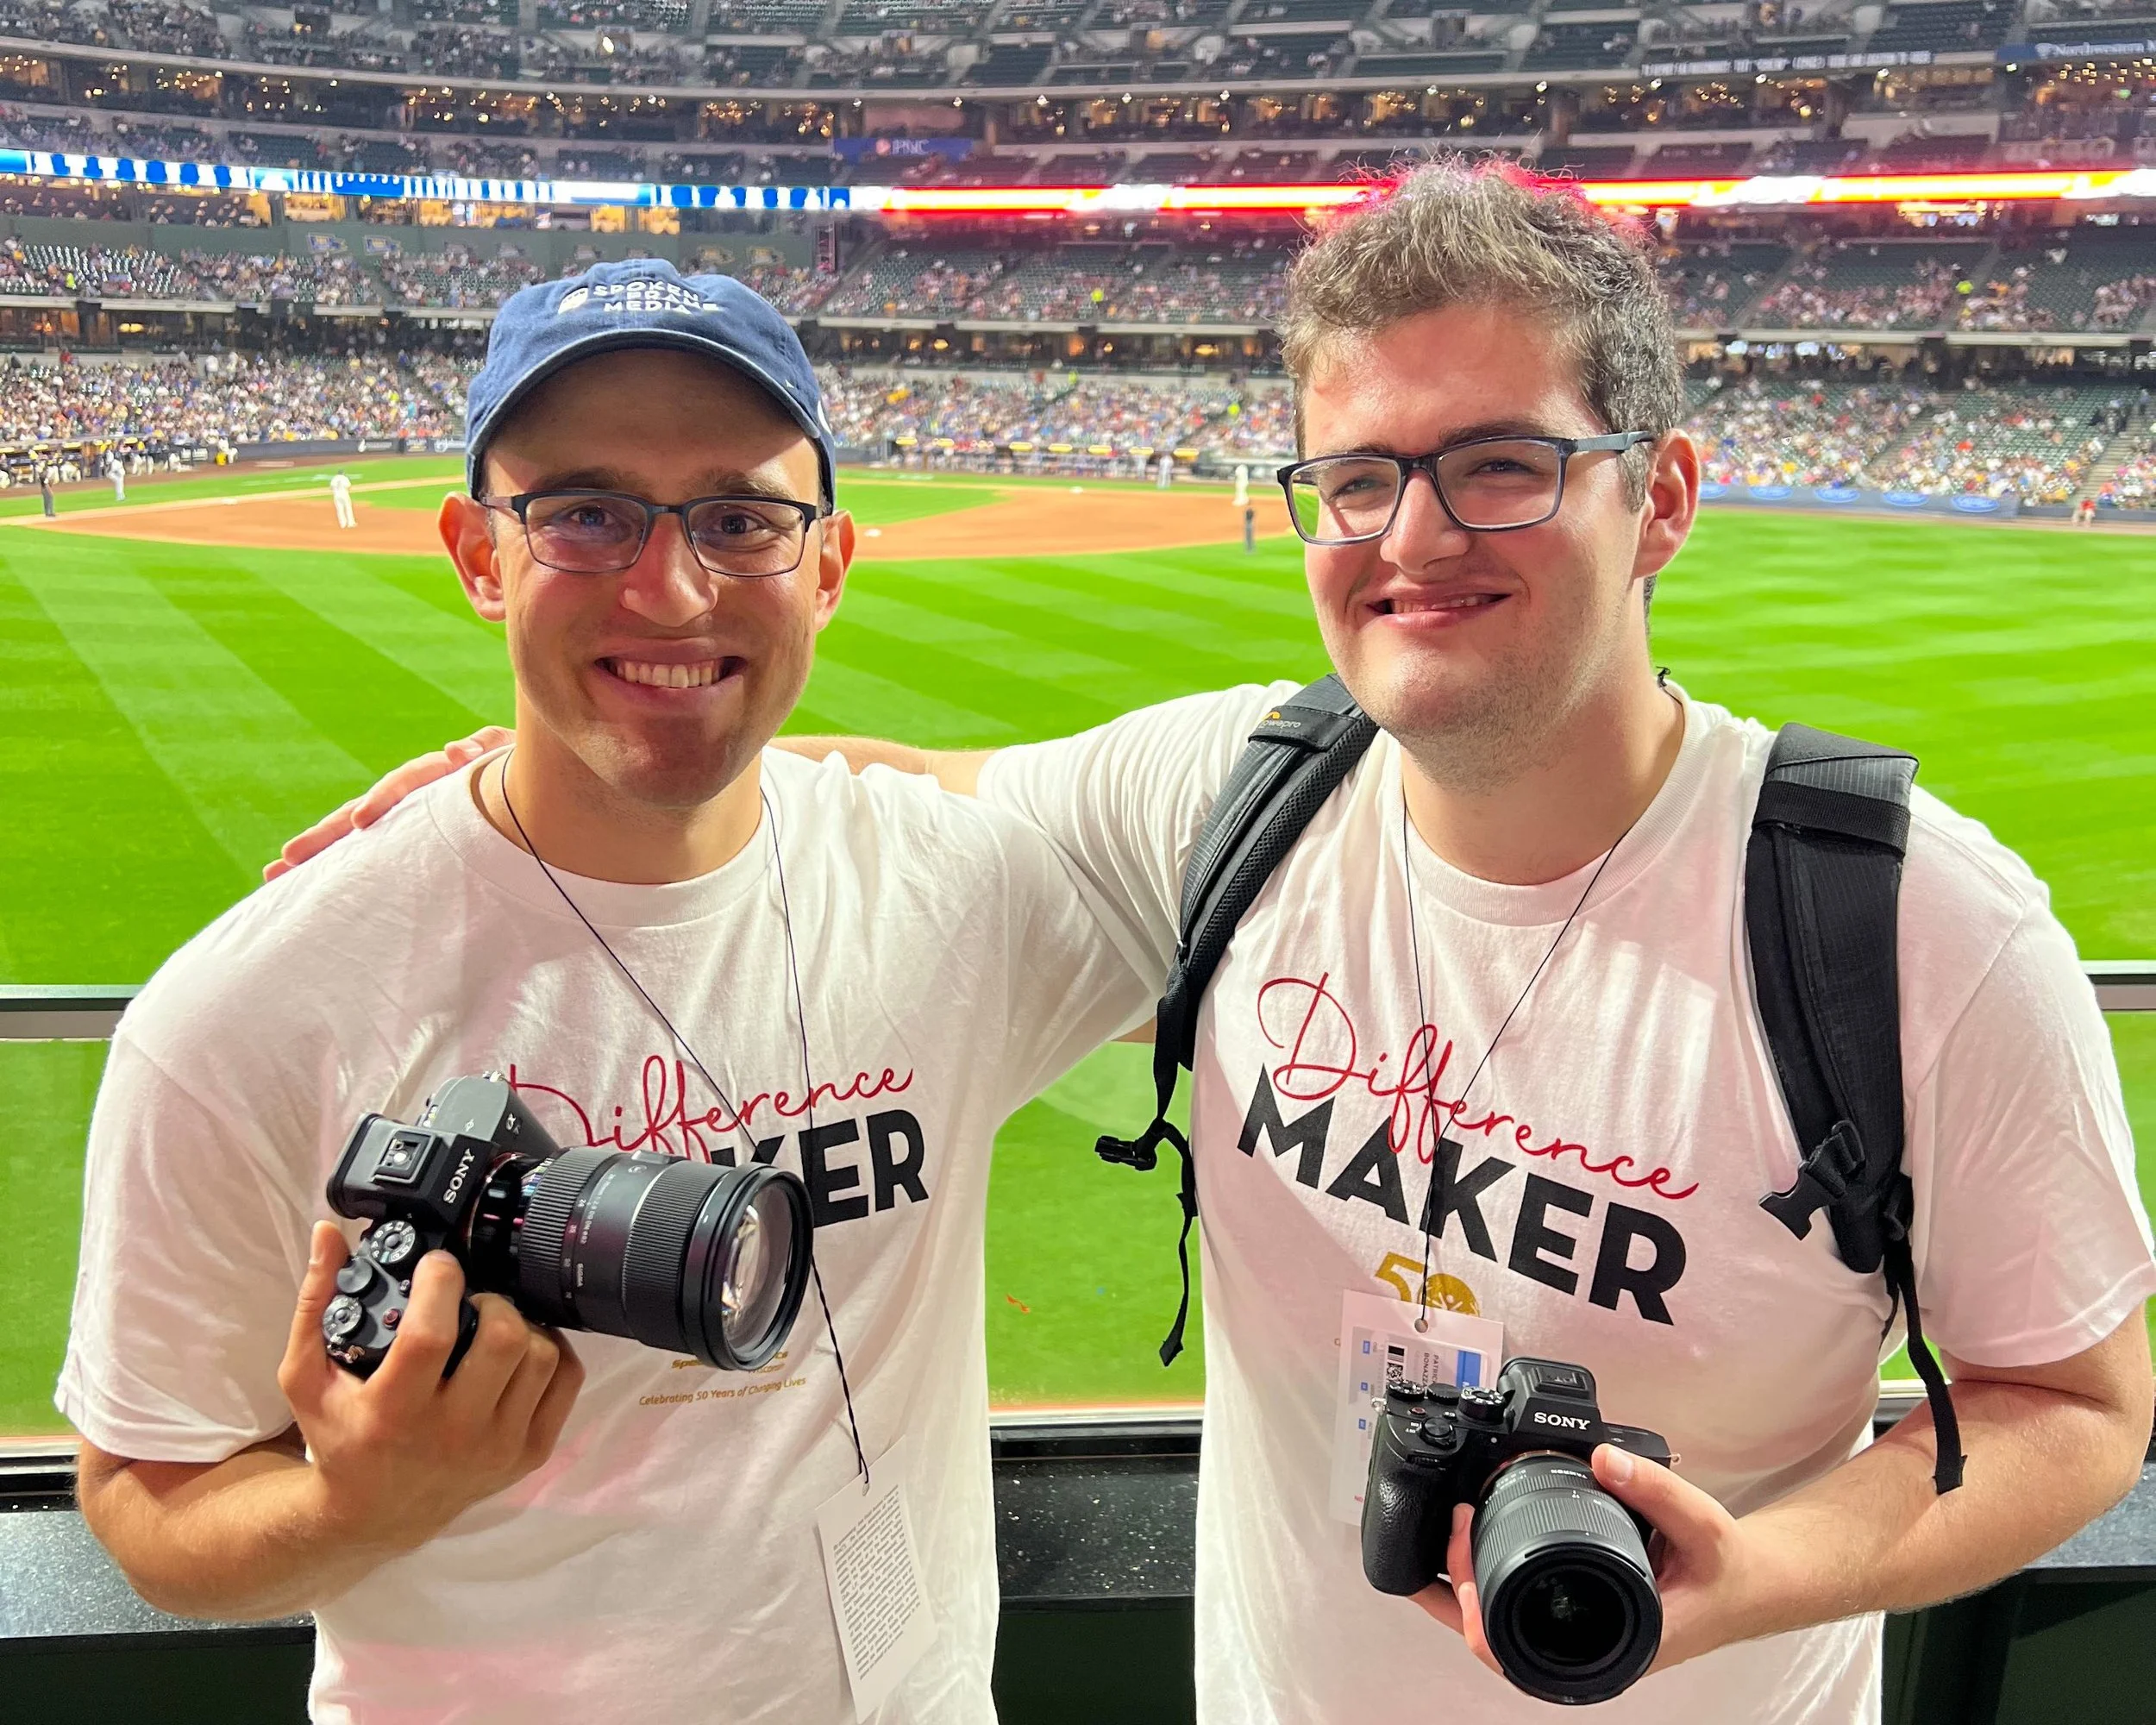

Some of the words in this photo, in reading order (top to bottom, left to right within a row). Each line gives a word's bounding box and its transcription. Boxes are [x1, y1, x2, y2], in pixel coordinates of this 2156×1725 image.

[892, 139, 930, 155] PNC
[593, 281, 699, 302] SPOKEN
[604, 300, 693, 315] MEDIA
[1257, 971, 1700, 1200] Difference
[443, 1148, 475, 1204] SONY
[1237, 1063, 1686, 1327] MAKER
[639, 1392, 694, 1406] Celebrating
[696, 1390, 708, 1402] 50
[711, 1389, 736, 1398] Years
[737, 1386, 749, 1398] of
[748, 1380, 782, 1396] Changing
[784, 1377, 807, 1389] Lives
[1533, 1411, 1591, 1431] SONY
